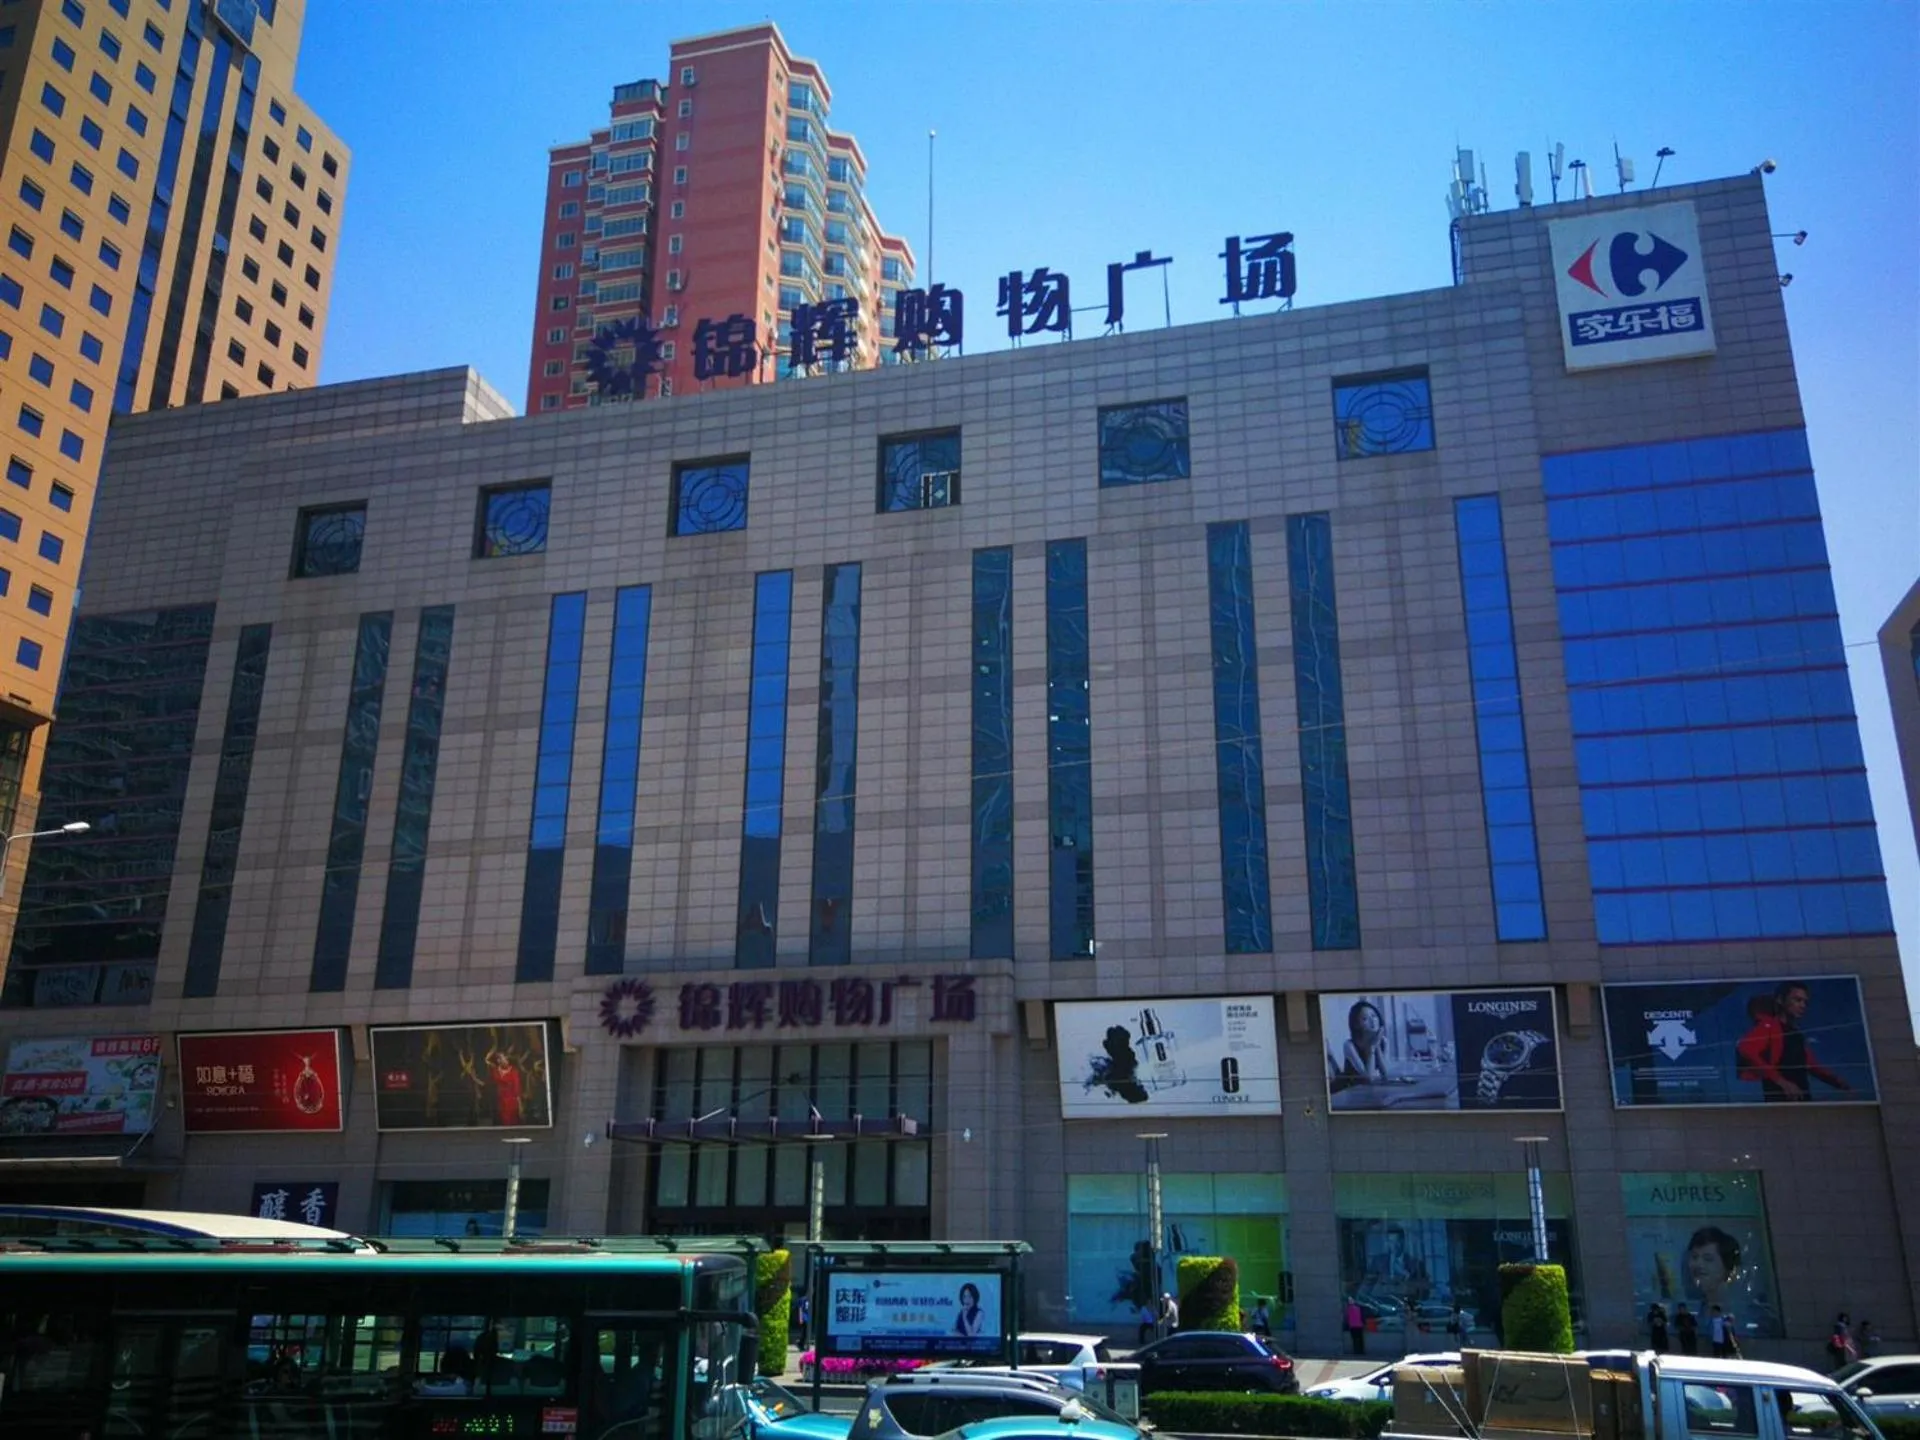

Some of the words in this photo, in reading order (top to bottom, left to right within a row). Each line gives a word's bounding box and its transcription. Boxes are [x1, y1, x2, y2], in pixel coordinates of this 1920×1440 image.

[690, 231, 1297, 381] 锦辉购物广场
[1576, 303, 1696, 340] 家乐福
[678, 974, 976, 1031] 锦辉购物广场
[1467, 1001, 1537, 1013] LONGINES
[1643, 1010, 1693, 1020] DESCENTE
[1651, 1186, 1726, 1203] AUPRES
[835, 1305, 867, 1323] 整形
